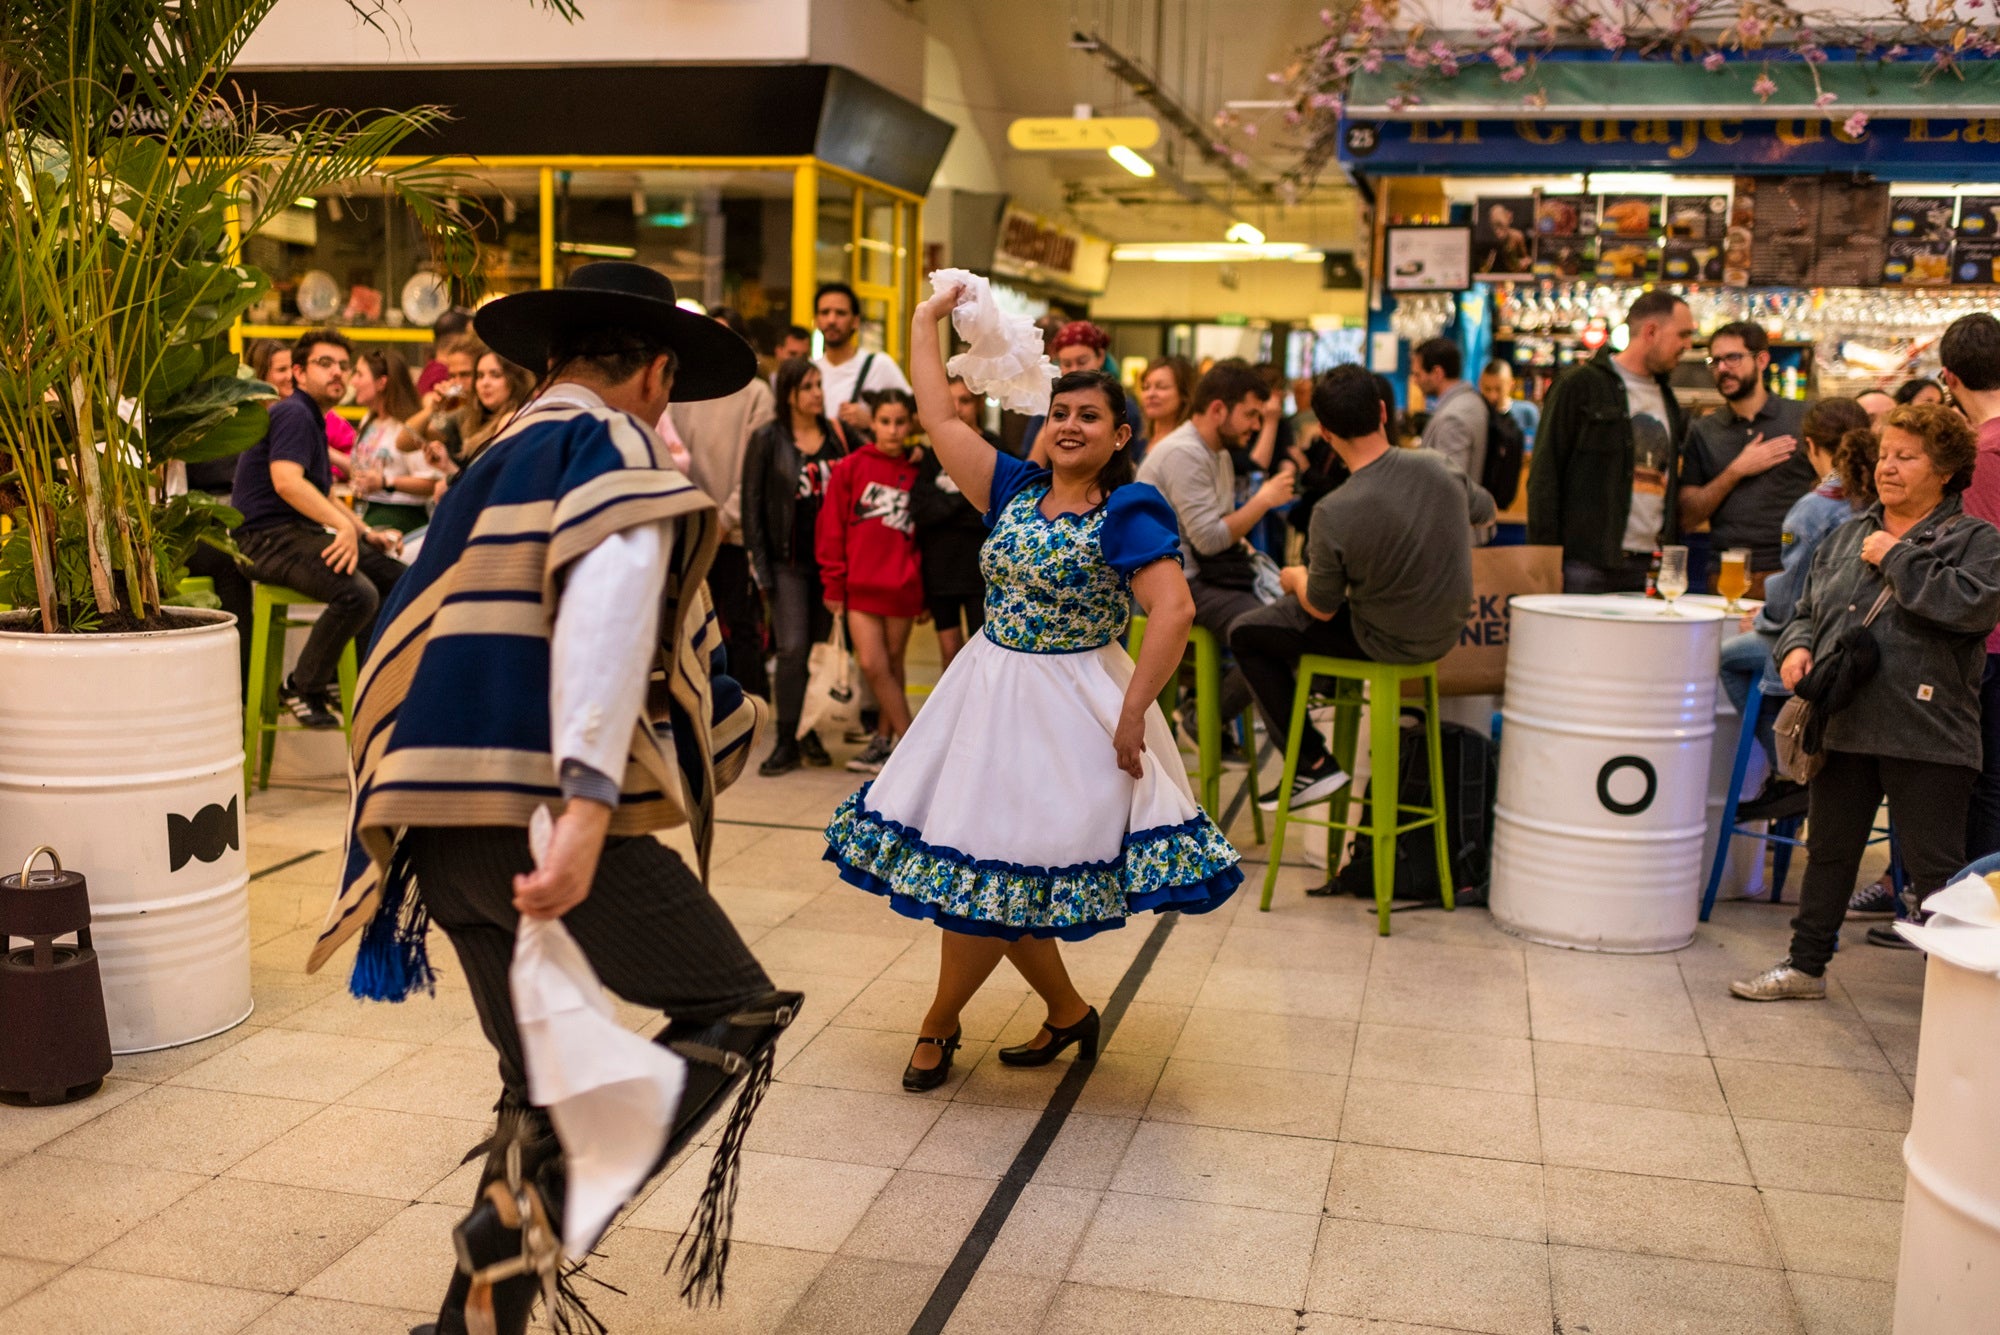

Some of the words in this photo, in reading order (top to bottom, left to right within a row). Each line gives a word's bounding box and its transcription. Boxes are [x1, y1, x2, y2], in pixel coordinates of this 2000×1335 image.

[1349, 128, 1375, 149] 25
[1408, 118, 1483, 144] El
[1514, 118, 1742, 160] Guaje
[1774, 118, 1872, 145] de
